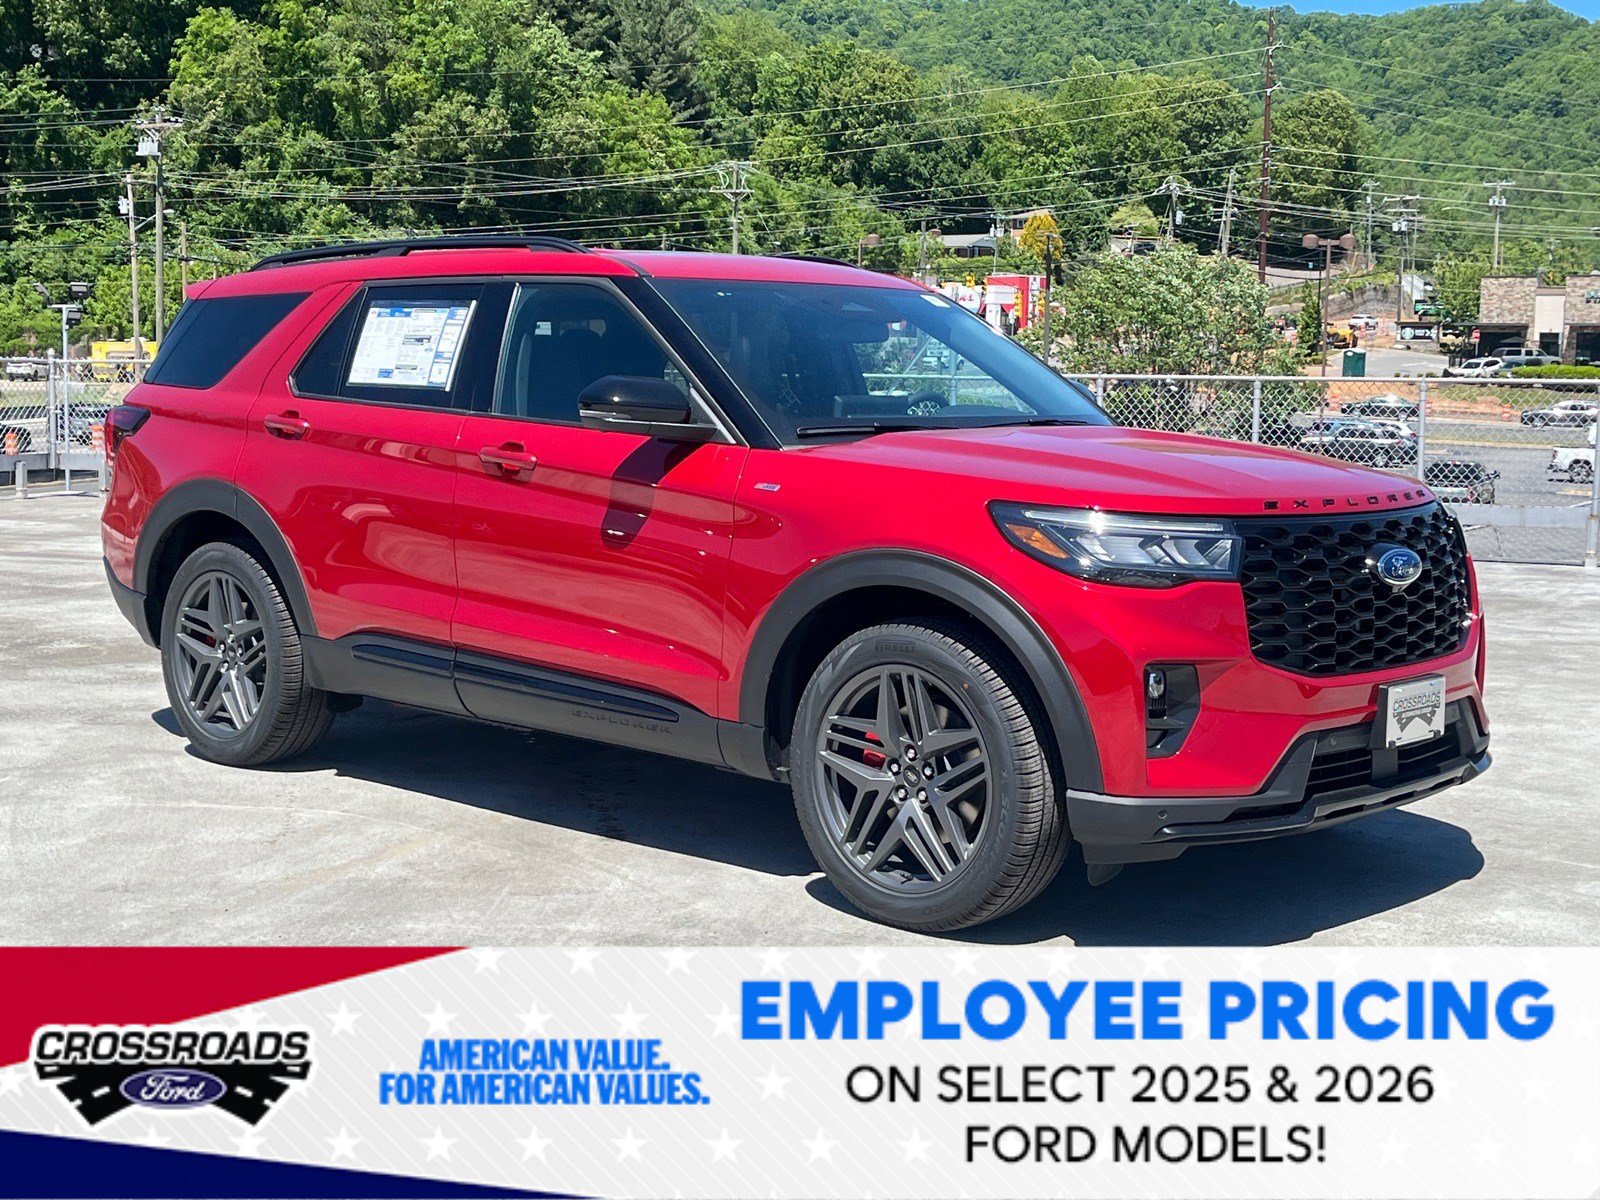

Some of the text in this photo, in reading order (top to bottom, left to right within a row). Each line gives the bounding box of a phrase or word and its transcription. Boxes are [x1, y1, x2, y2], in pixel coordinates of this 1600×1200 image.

[1263, 489, 1426, 510] EXPLORER
[1393, 691, 1441, 712] CROSSROADS
[572, 709, 672, 734] EXPLORER
